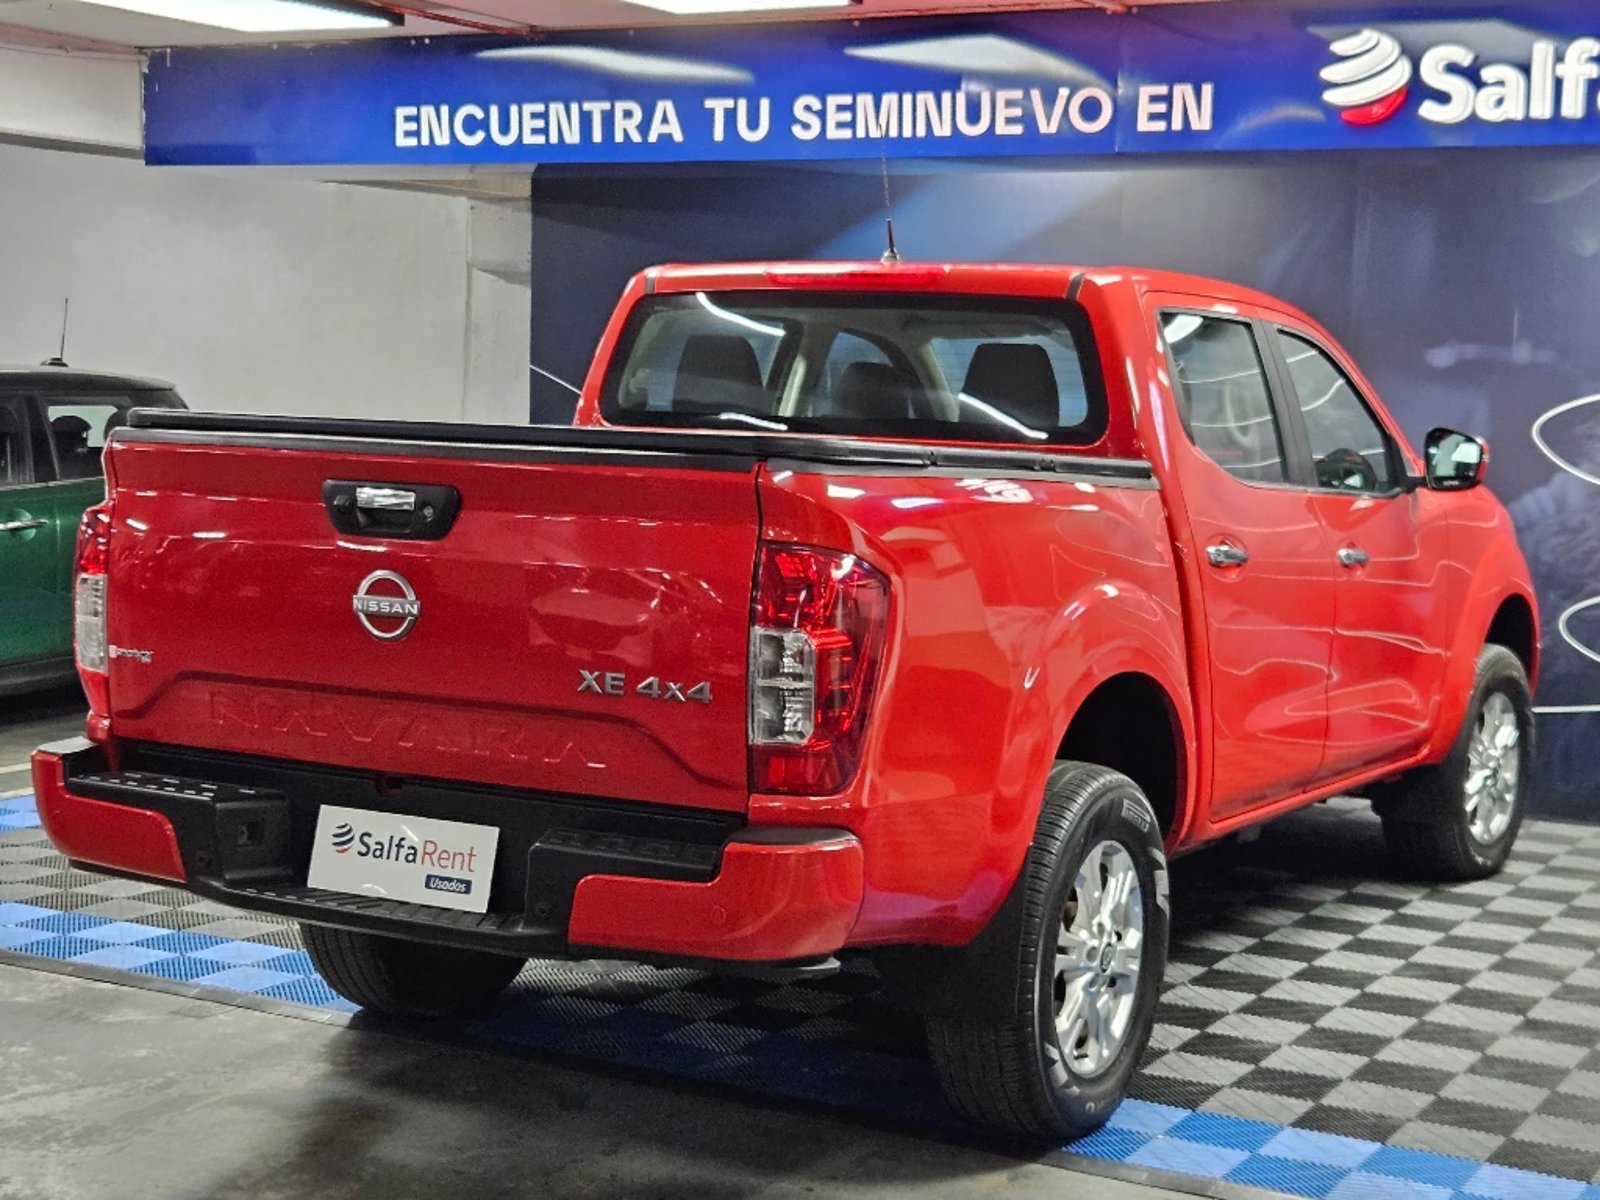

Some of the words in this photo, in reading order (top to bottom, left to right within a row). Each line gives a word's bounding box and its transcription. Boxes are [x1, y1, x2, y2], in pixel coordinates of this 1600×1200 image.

[1417, 37, 1600, 124] Salf
[394, 99, 684, 148] ENCUENTRA
[704, 97, 770, 142] TU
[790, 86, 1113, 141] SEMINUEVO
[1136, 82, 1214, 133] EN
[353, 597, 419, 615] NISSAN
[577, 669, 626, 696] XE
[636, 676, 713, 704] 4x4
[357, 831, 477, 873] SalfaRent
[430, 876, 467, 892] Usados
